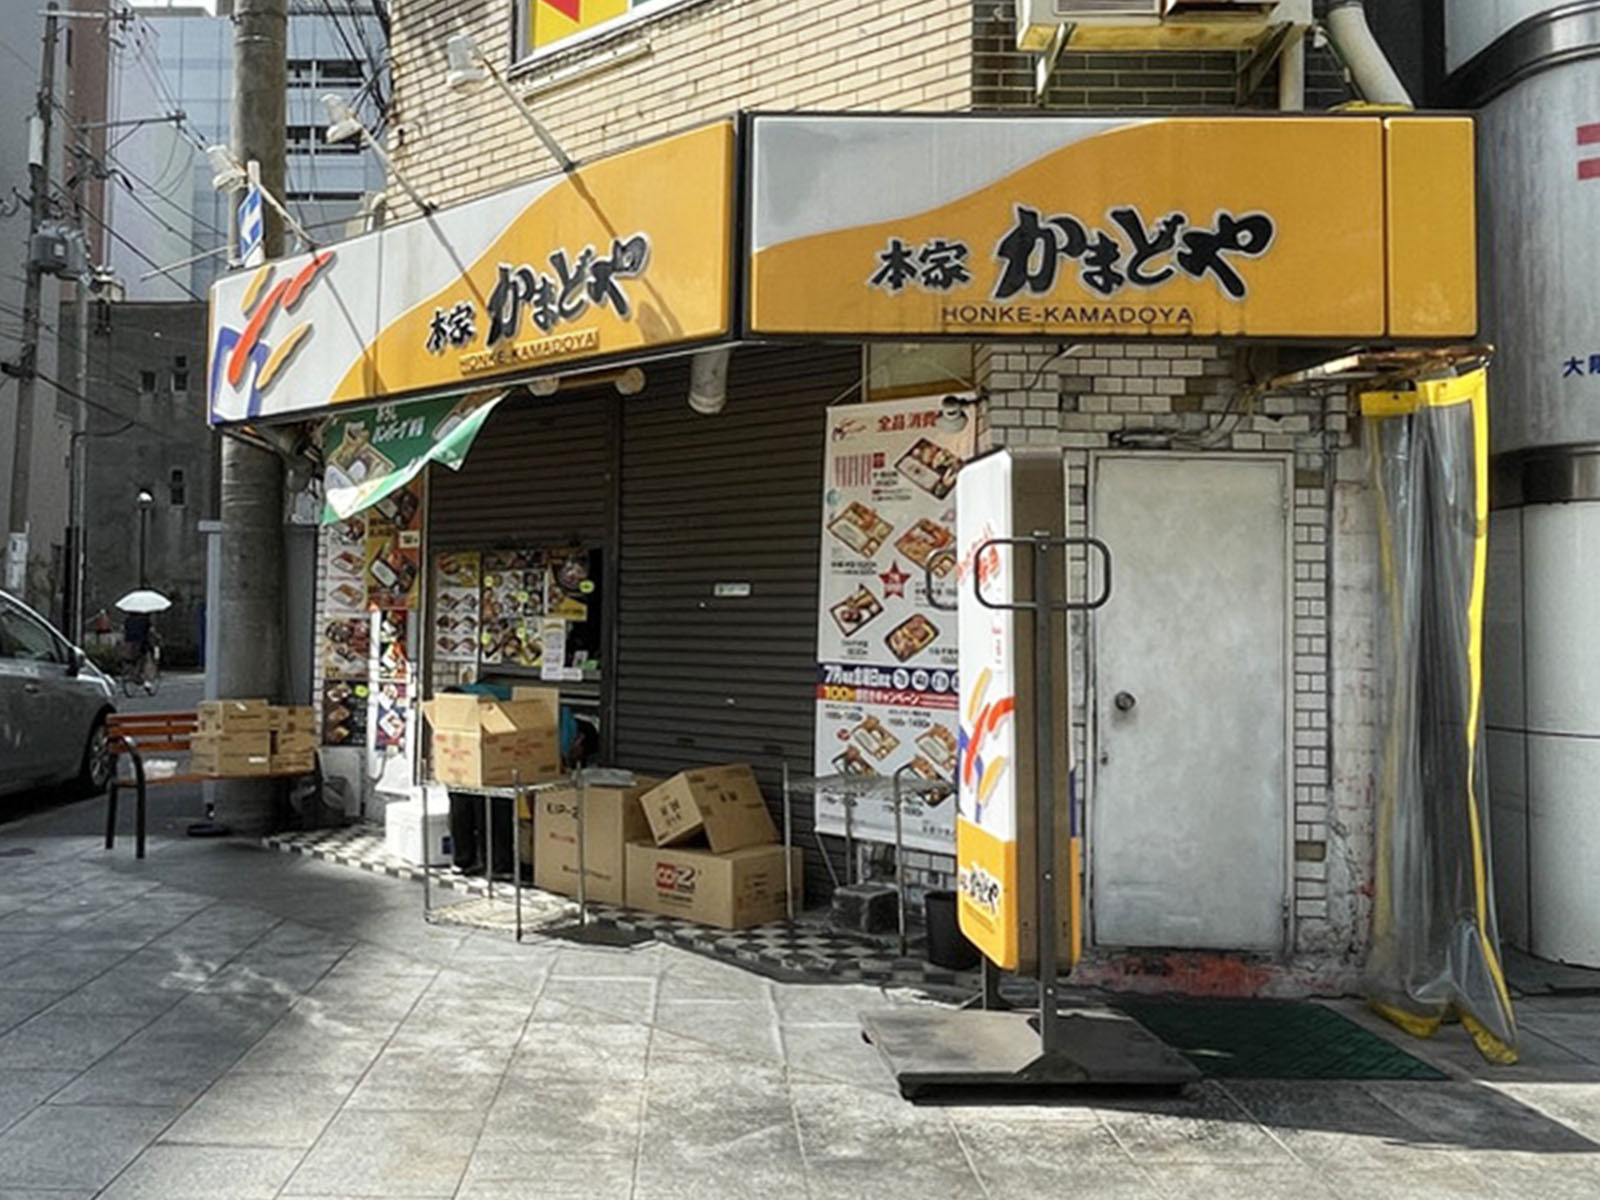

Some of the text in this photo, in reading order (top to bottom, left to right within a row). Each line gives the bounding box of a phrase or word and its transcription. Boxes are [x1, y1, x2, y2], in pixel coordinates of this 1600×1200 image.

[427, 234, 649, 353] 本家 かまどや
[870, 205, 1275, 301] 本家 かまどや
[942, 305, 1195, 325] HONKE-KAMADOYA
